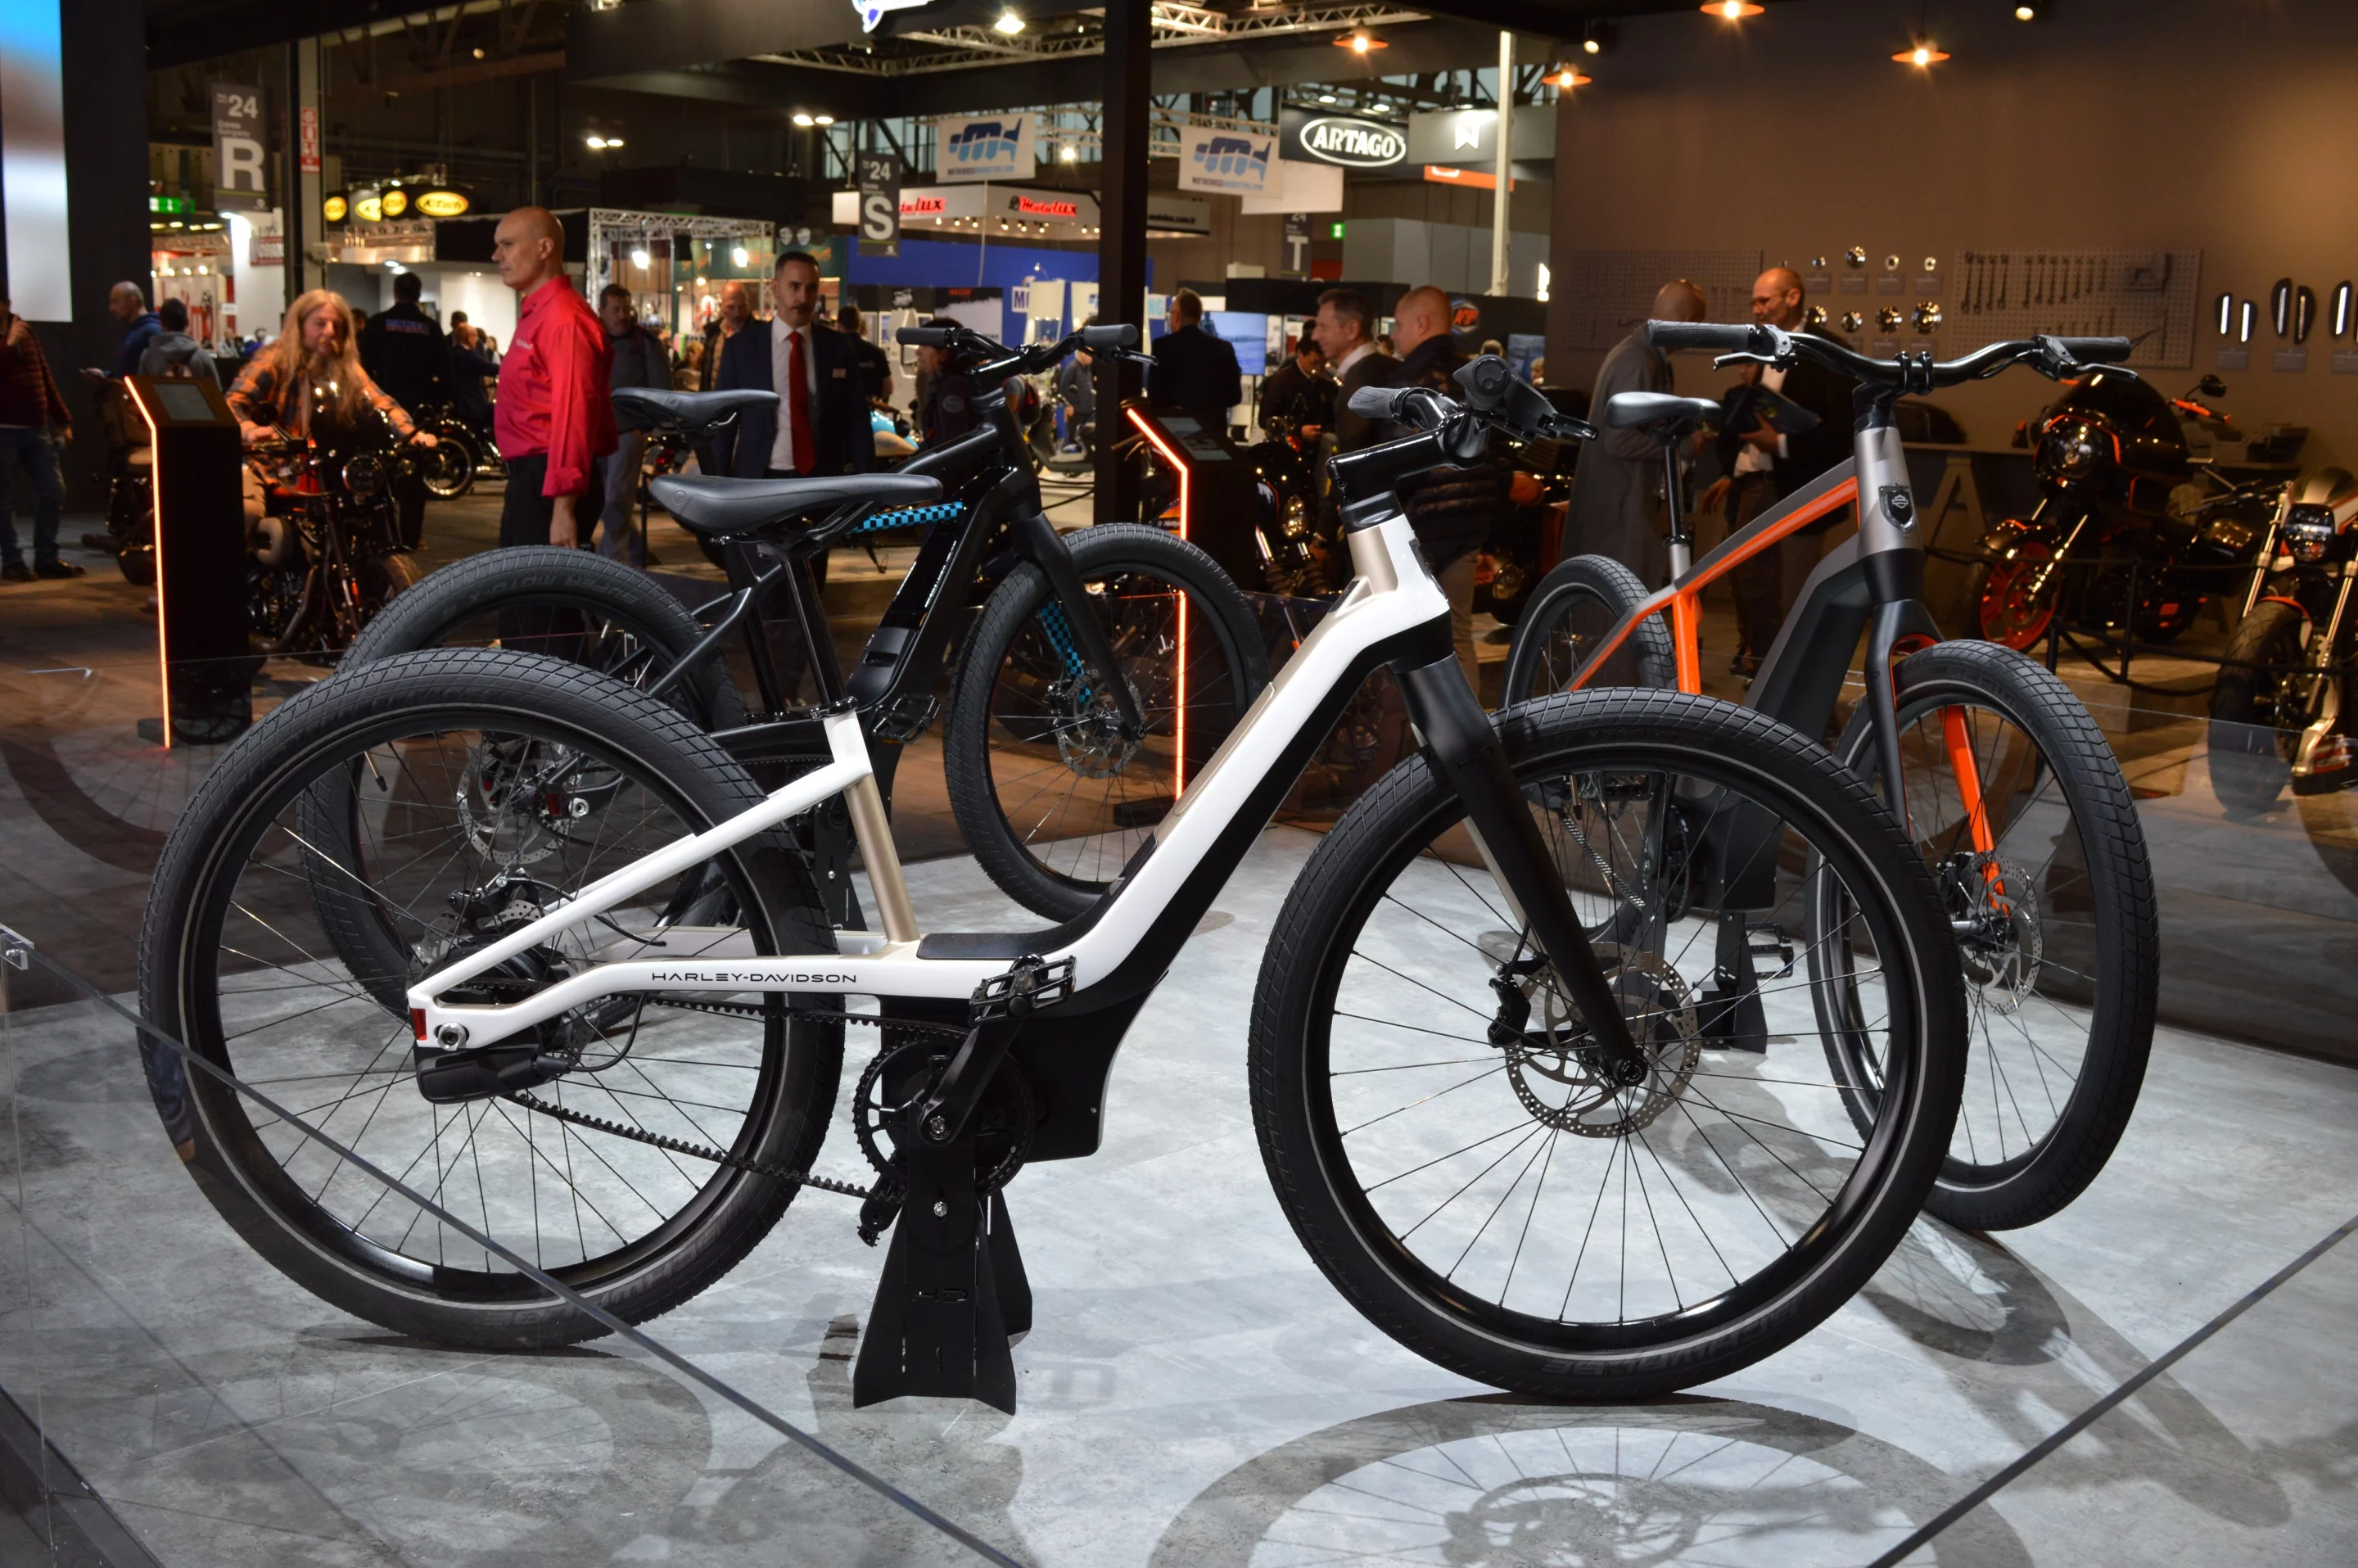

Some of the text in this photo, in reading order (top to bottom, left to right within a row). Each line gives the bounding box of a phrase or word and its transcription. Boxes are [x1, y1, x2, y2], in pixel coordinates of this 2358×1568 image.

[228, 94, 259, 119] 24
[1312, 124, 1396, 158] ARTAGO
[222, 137, 265, 192] R
[870, 160, 891, 181] 24
[864, 197, 894, 241] S
[1287, 234, 1309, 271] T
[652, 973, 856, 983] HARLEY-DAVIDSON
